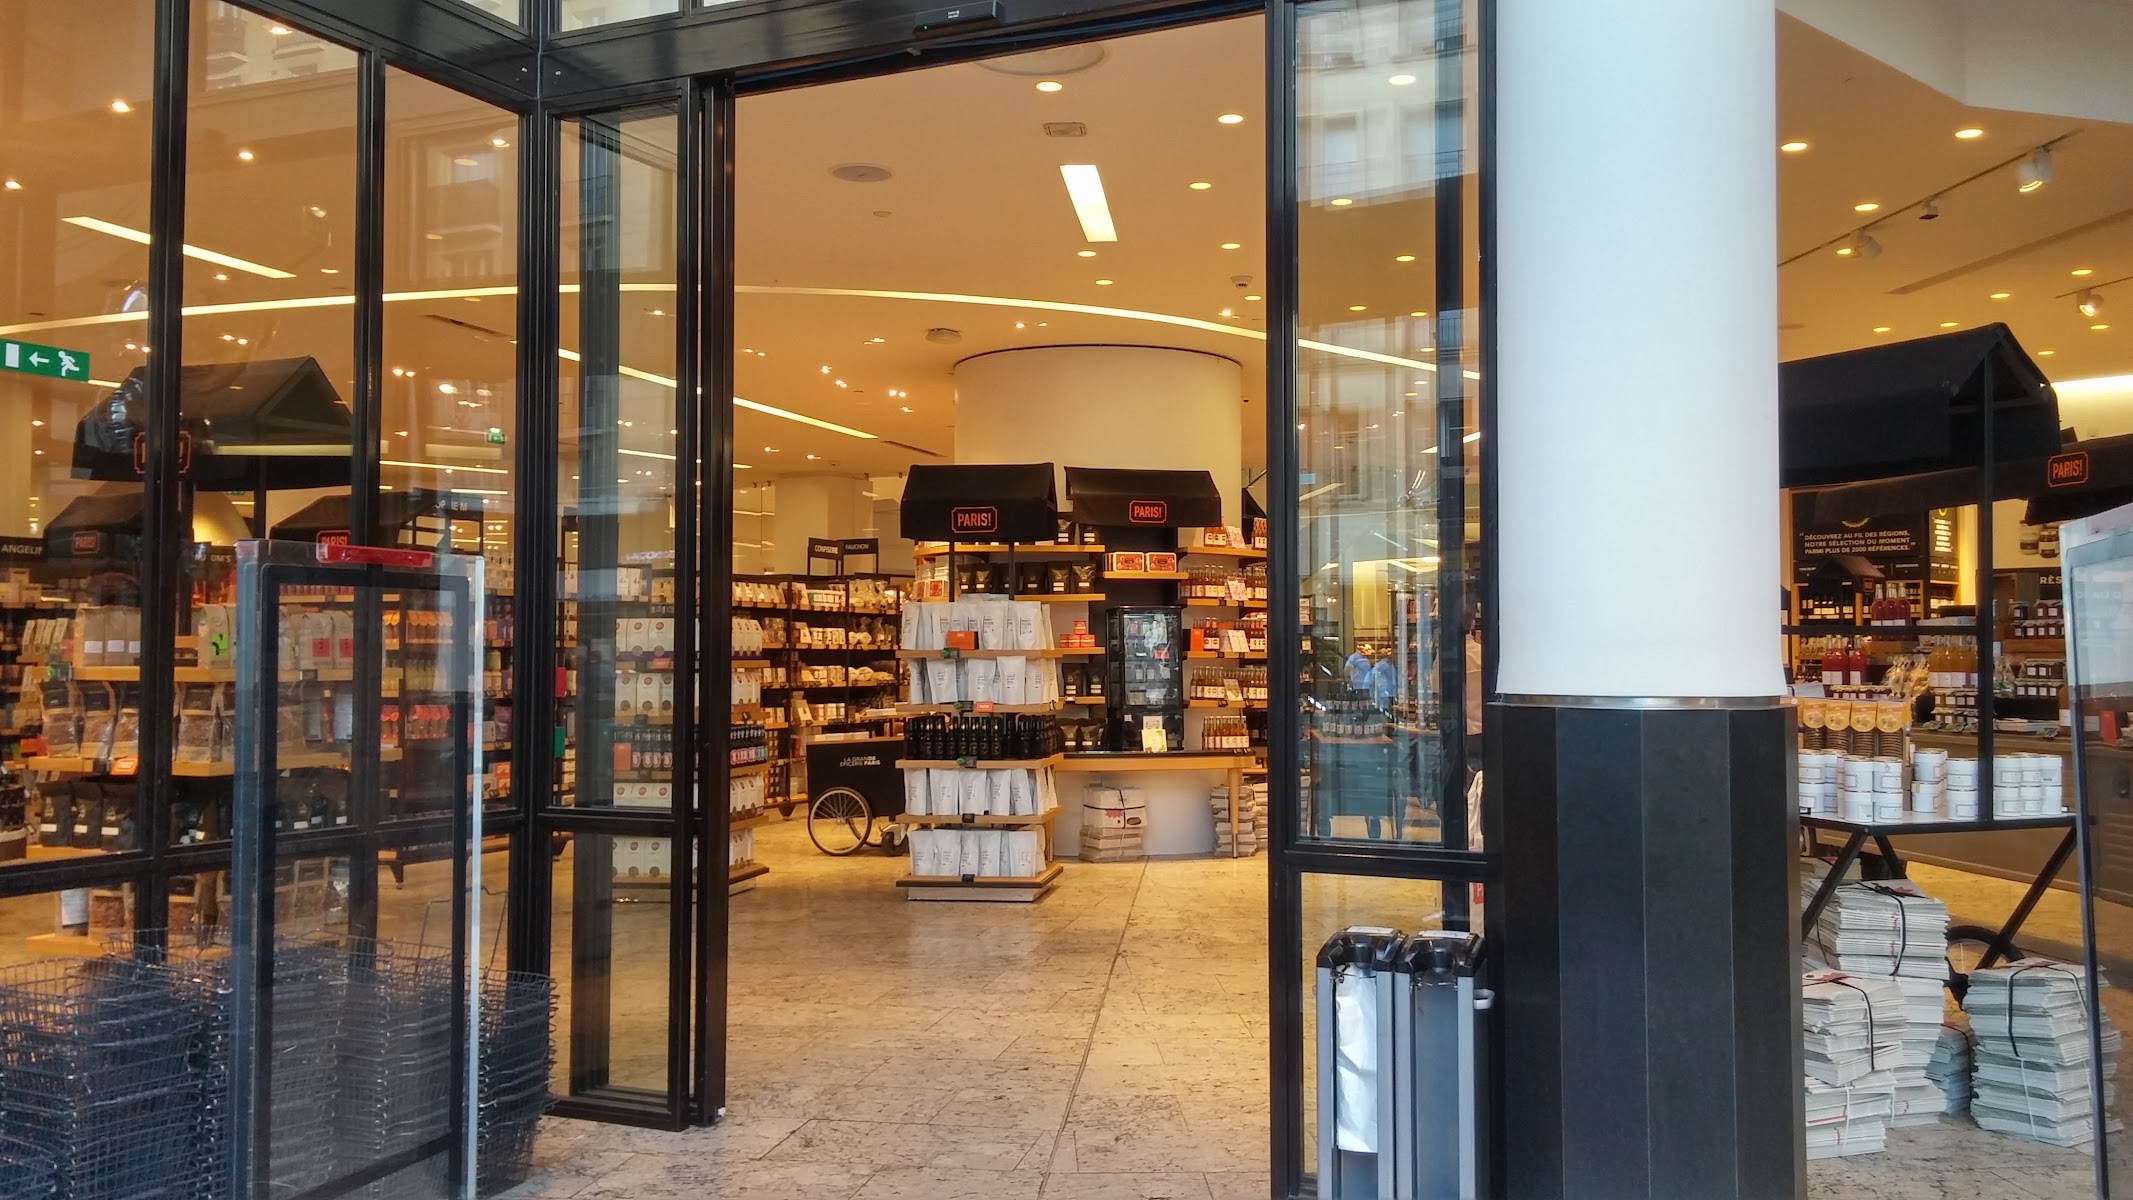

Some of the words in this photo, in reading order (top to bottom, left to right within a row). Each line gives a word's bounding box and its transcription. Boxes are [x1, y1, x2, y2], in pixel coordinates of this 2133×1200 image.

[2052, 459, 2083, 479] PARIS!
[1134, 505, 1162, 518] PARIS!
[957, 512, 992, 527] PARIS!
[1828, 539, 1865, 547] SÉLECTION
